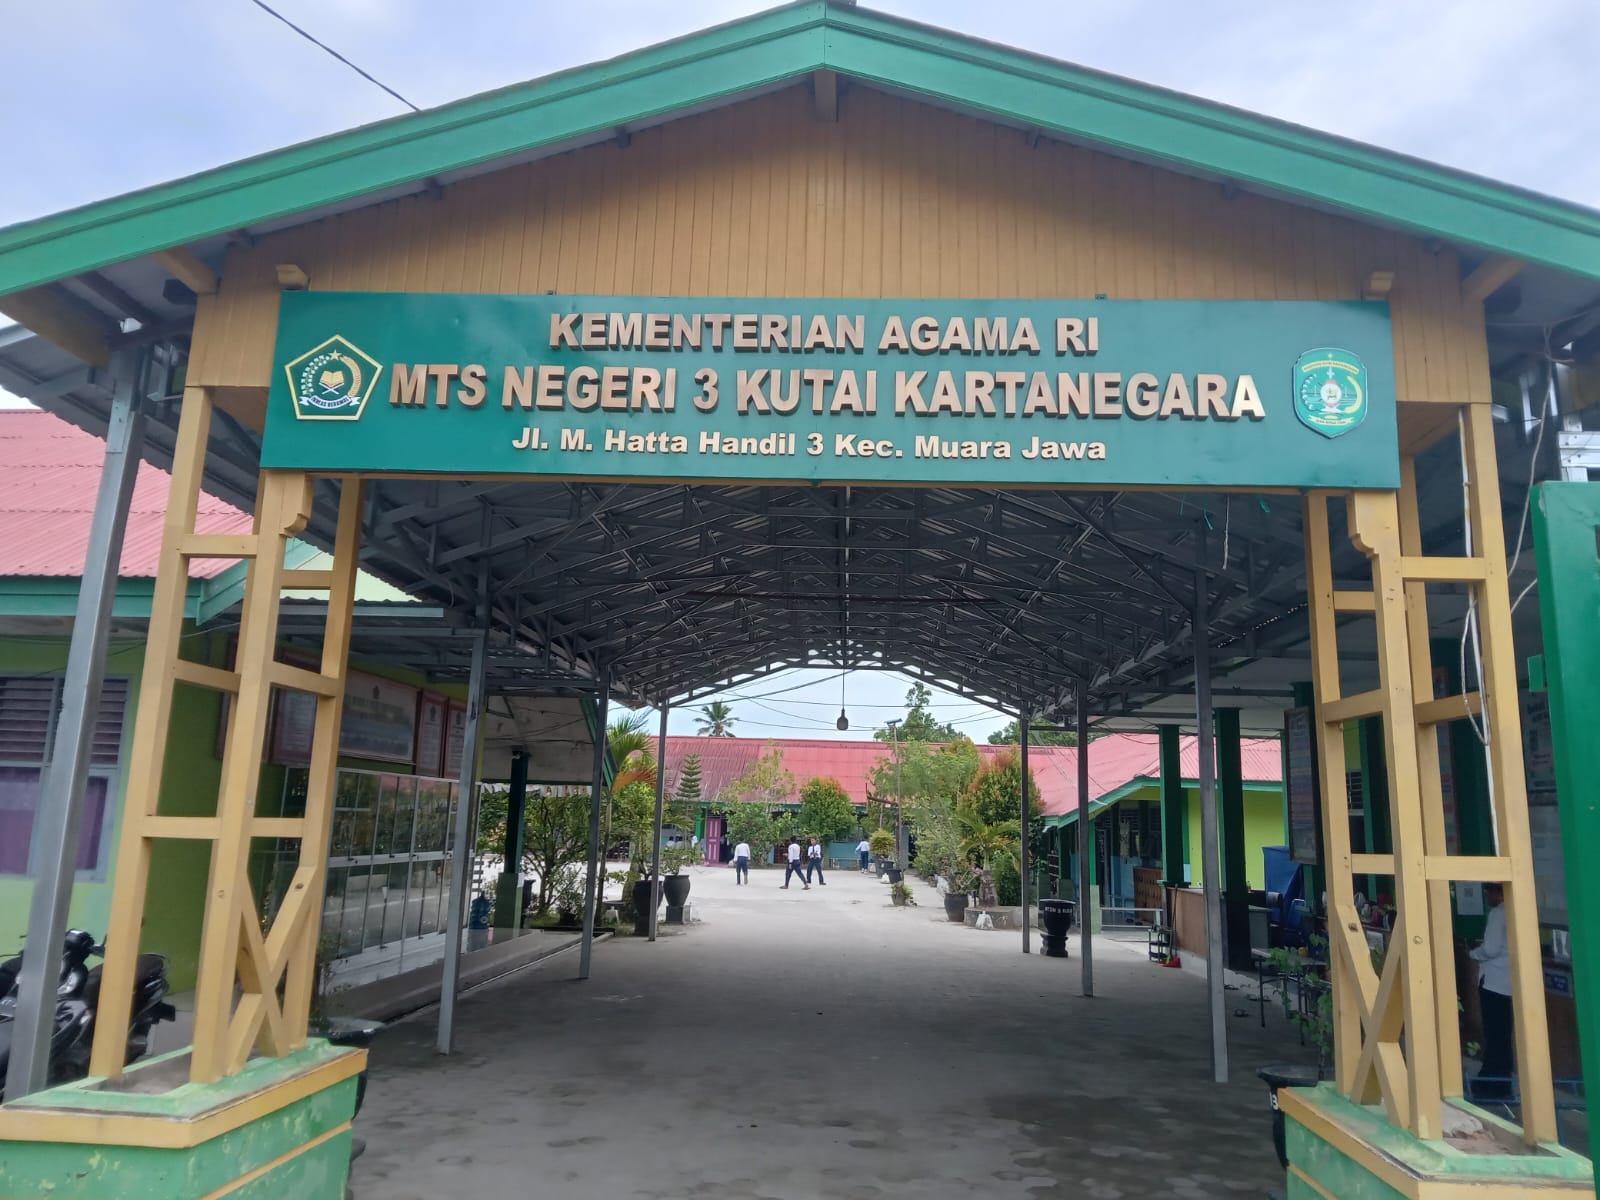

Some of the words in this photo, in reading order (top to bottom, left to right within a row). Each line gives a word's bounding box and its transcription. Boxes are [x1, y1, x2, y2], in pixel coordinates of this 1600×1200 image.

[550, 312, 865, 352] KEMENTERIAN
[878, 315, 1040, 355] AGAMA
[1055, 317, 1099, 356] RI
[389, 363, 487, 408] MTS
[501, 365, 677, 412] NEGERI
[693, 367, 719, 412] 3
[736, 369, 877, 416] KUTAI
[895, 370, 1266, 421] KARTANEGARA
[512, 427, 548, 450] Jl.
[560, 428, 593, 451] M.
[604, 429, 688, 453] Hatta
[699, 431, 795, 455] Handil
[806, 433, 824, 456] 3
[835, 434, 903, 458] Kec.
[914, 435, 1011, 459] Muara
[1021, 436, 1106, 460] Jawa
